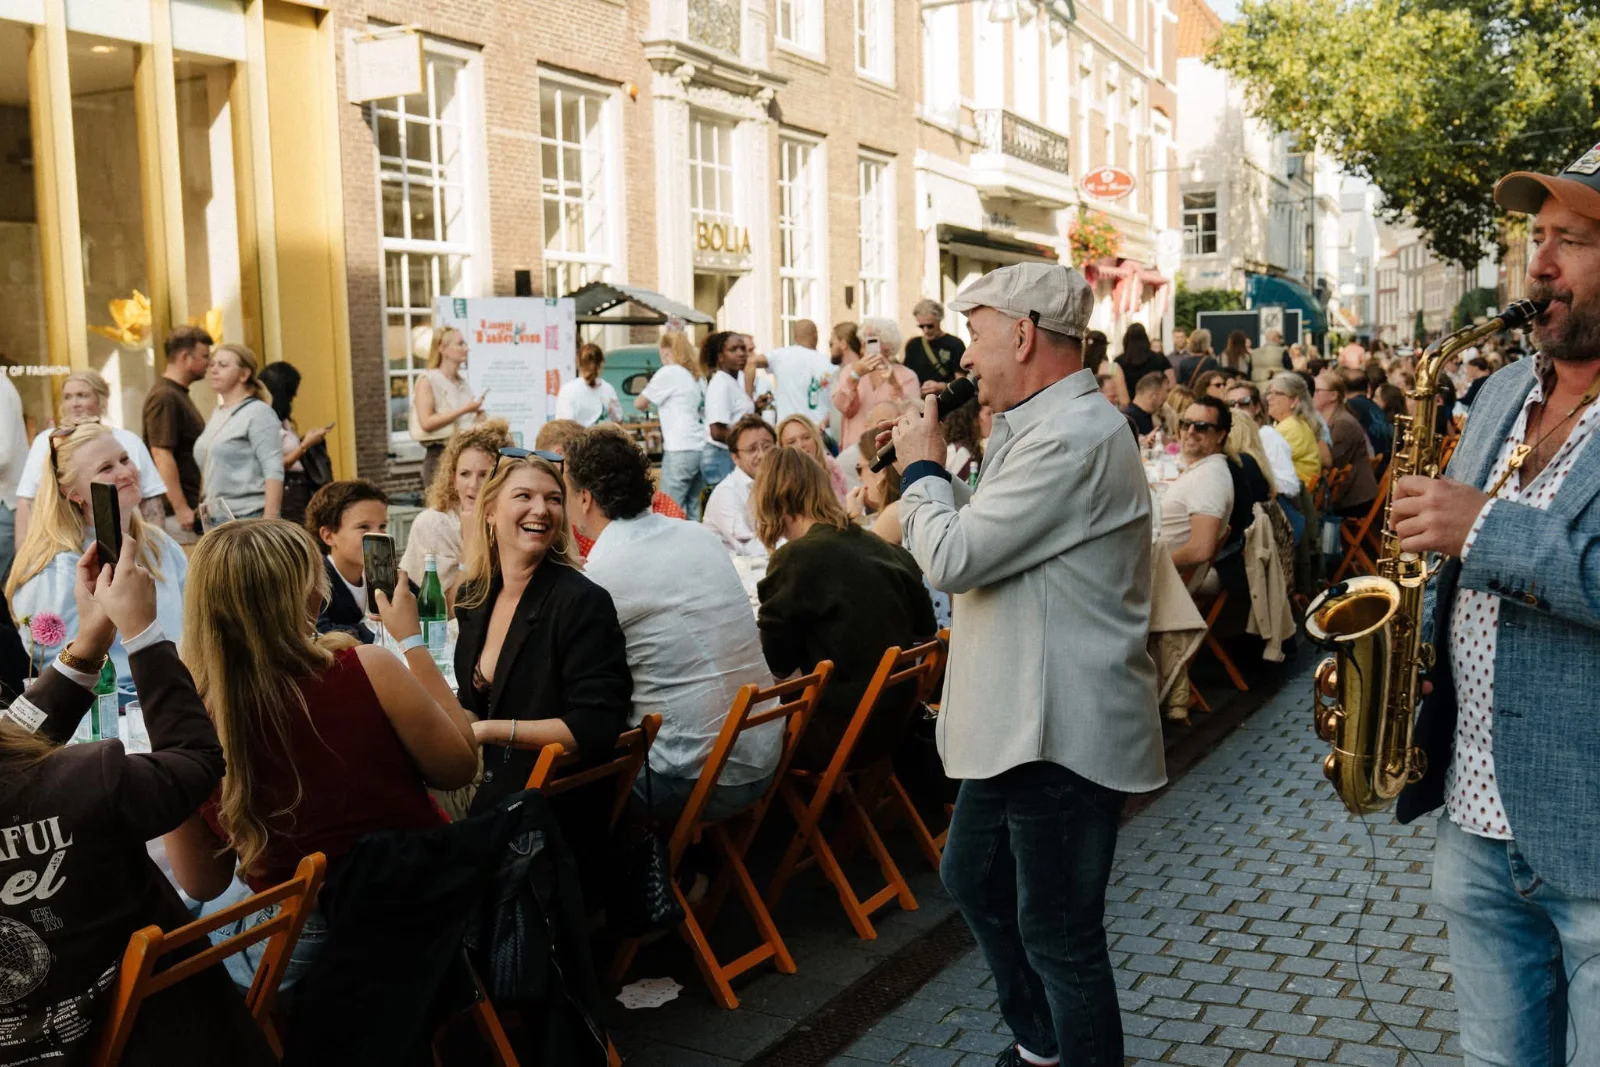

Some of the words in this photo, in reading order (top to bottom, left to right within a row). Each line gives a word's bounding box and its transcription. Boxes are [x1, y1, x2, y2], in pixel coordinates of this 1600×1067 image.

[696, 220, 753, 254] BOLIA
[9, 365, 24, 376] OF
[26, 365, 71, 376] FASHION
[30, 906, 57, 923] REBEL
[42, 918, 64, 932] DISCO
